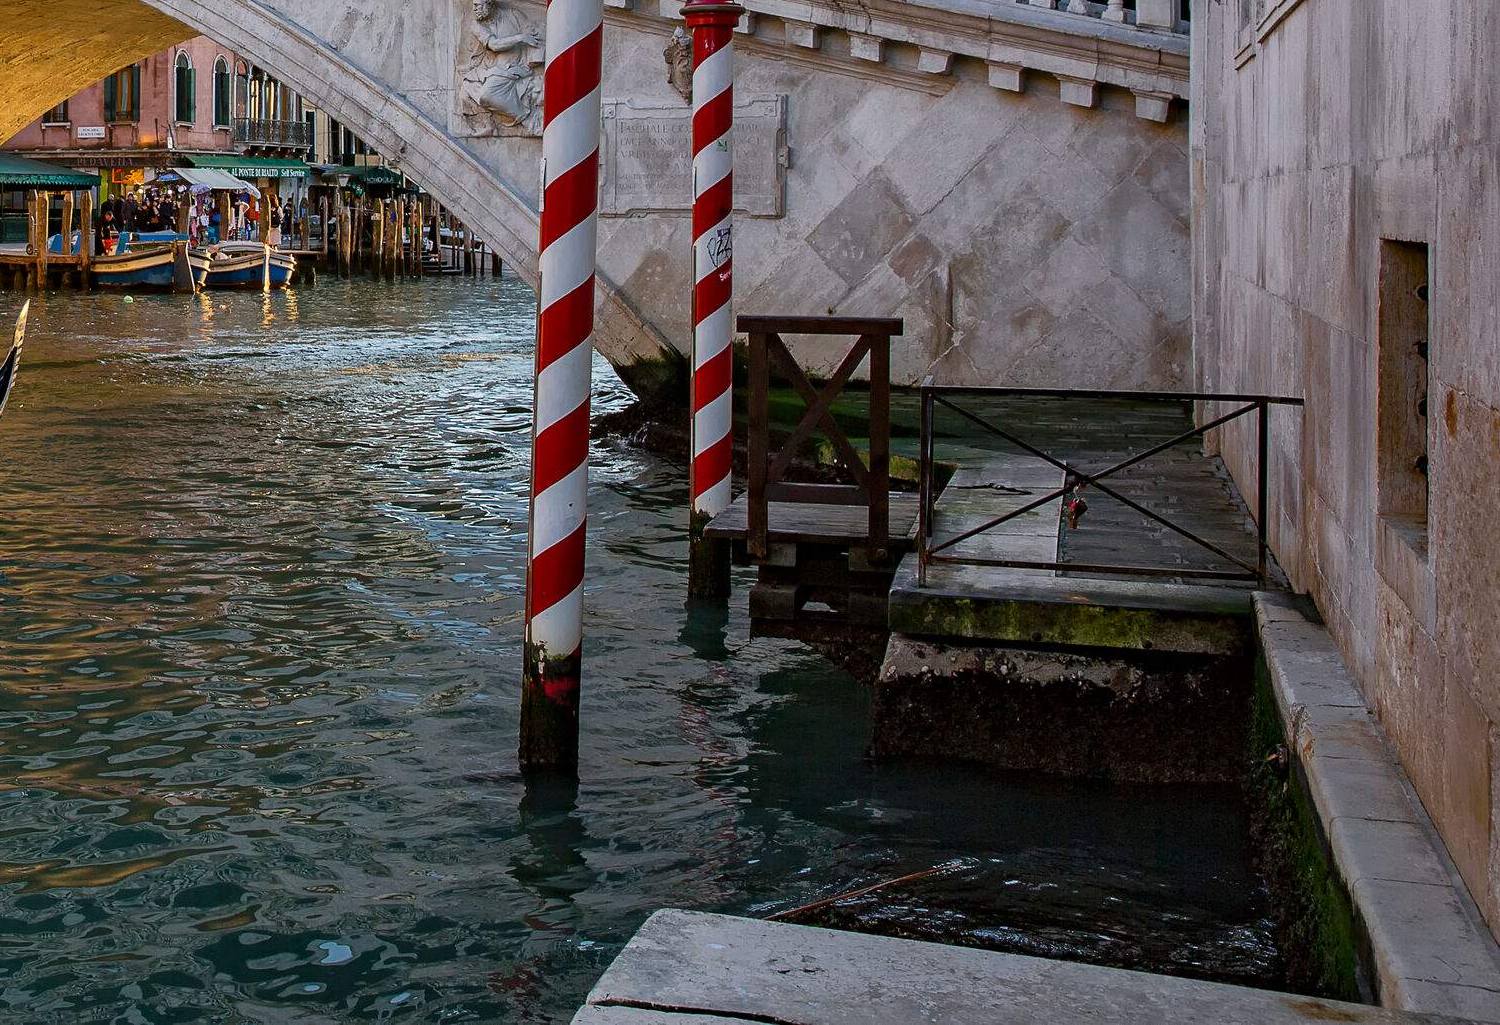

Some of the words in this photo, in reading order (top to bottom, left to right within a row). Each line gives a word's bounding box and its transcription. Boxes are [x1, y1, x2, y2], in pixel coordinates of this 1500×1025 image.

[238, 168, 255, 177] PONTE
[255, 168, 261, 177] DI
[261, 168, 278, 177] RIALTO
[290, 168, 305, 177] Service
